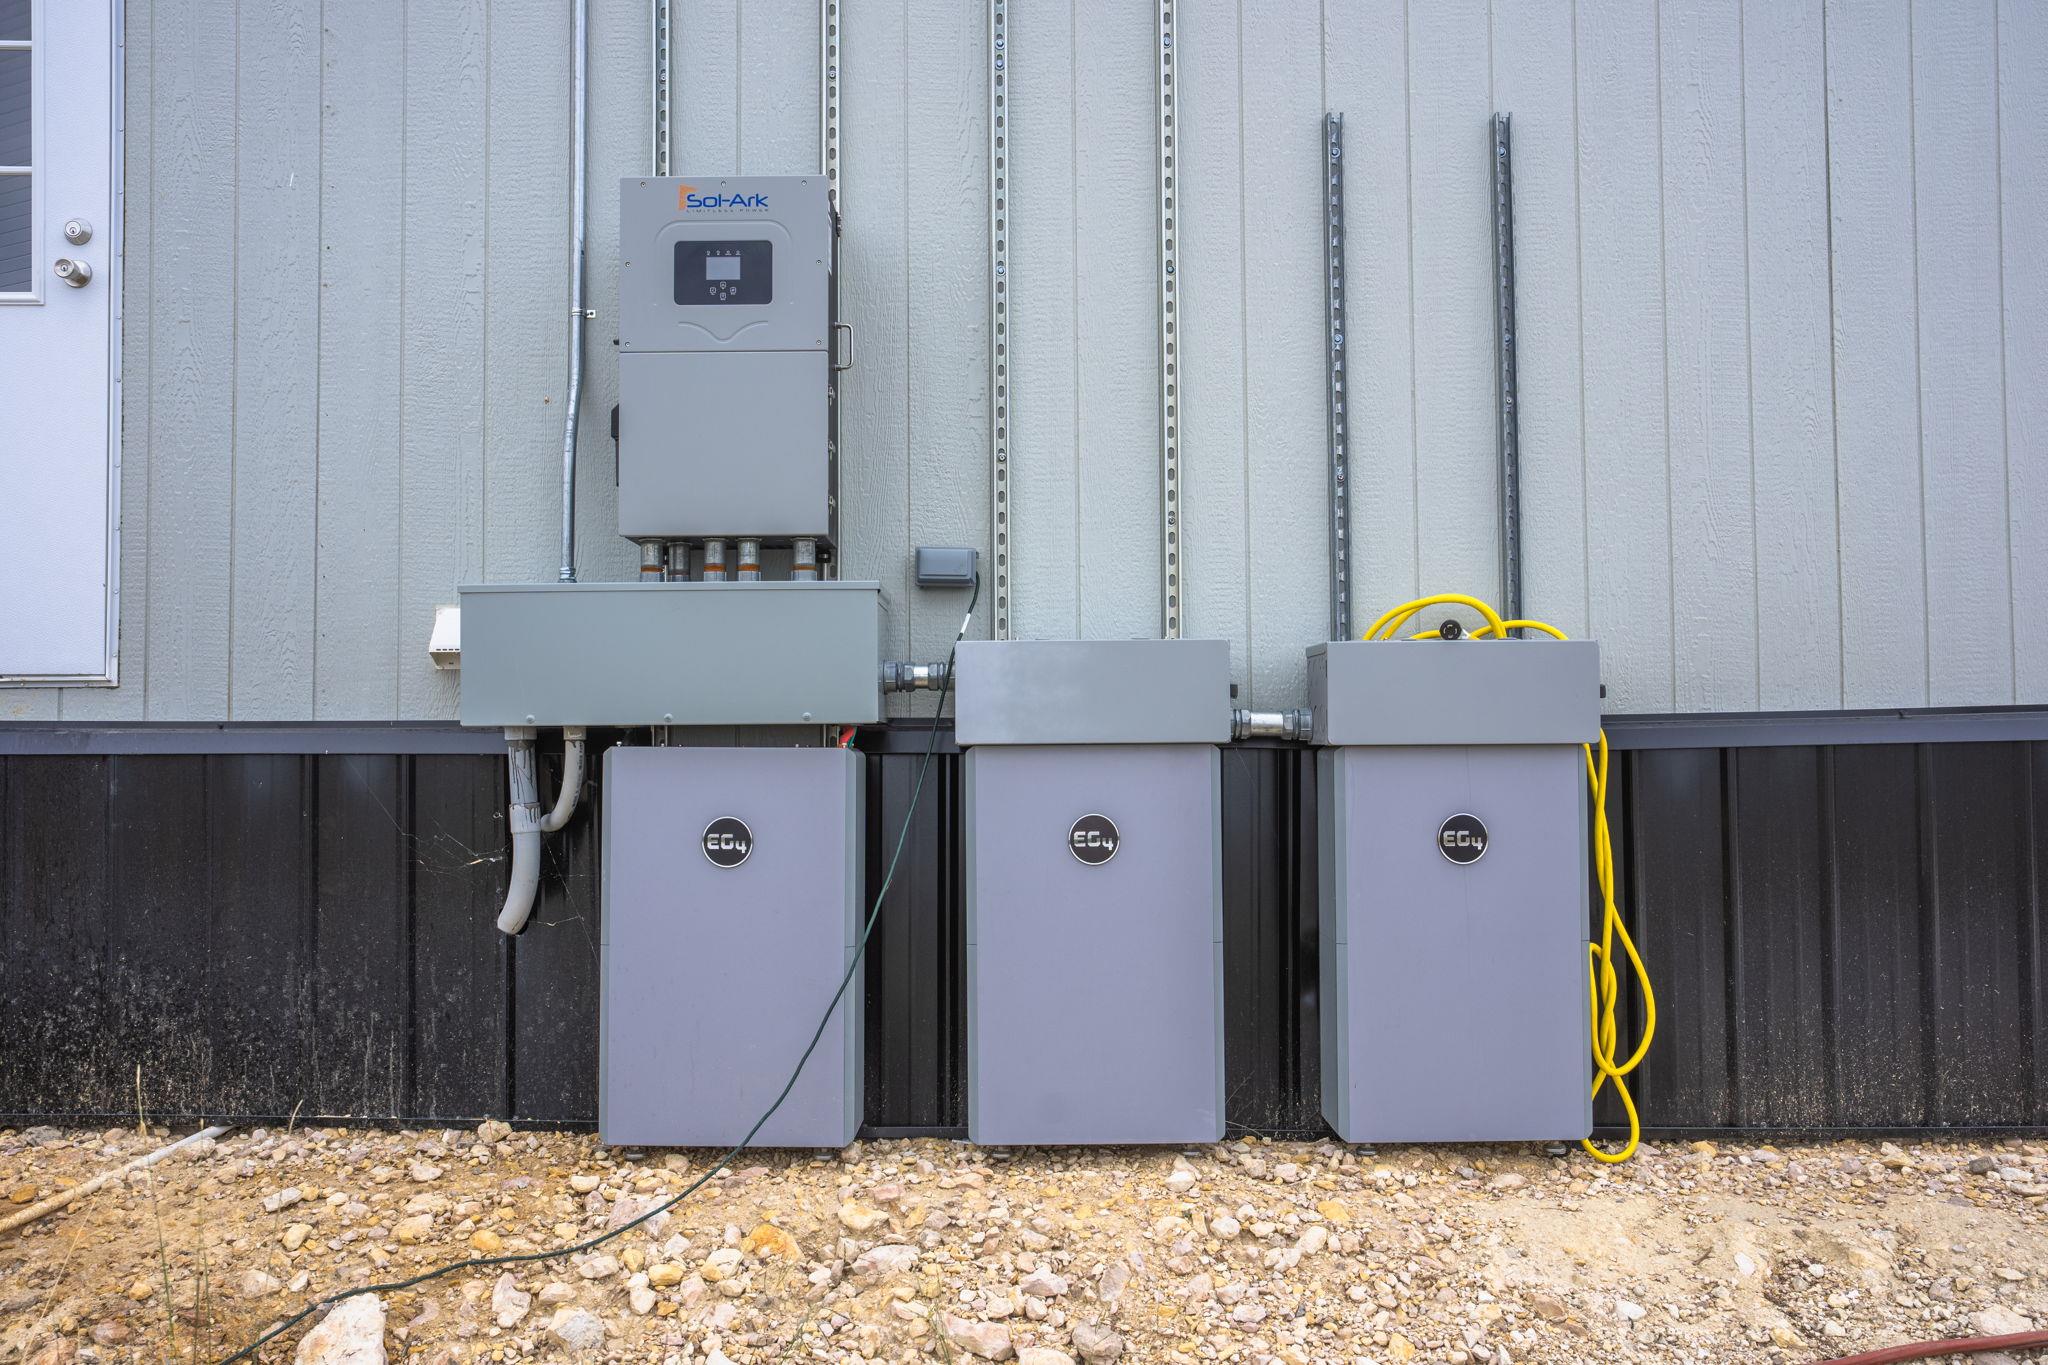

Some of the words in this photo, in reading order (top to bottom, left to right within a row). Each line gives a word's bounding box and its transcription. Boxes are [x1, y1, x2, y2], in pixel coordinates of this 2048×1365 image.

[686, 193, 769, 208] Sol-Ark
[707, 833, 747, 854] EG4
[1073, 831, 1114, 851] EG4
[1443, 830, 1483, 850] EG4
